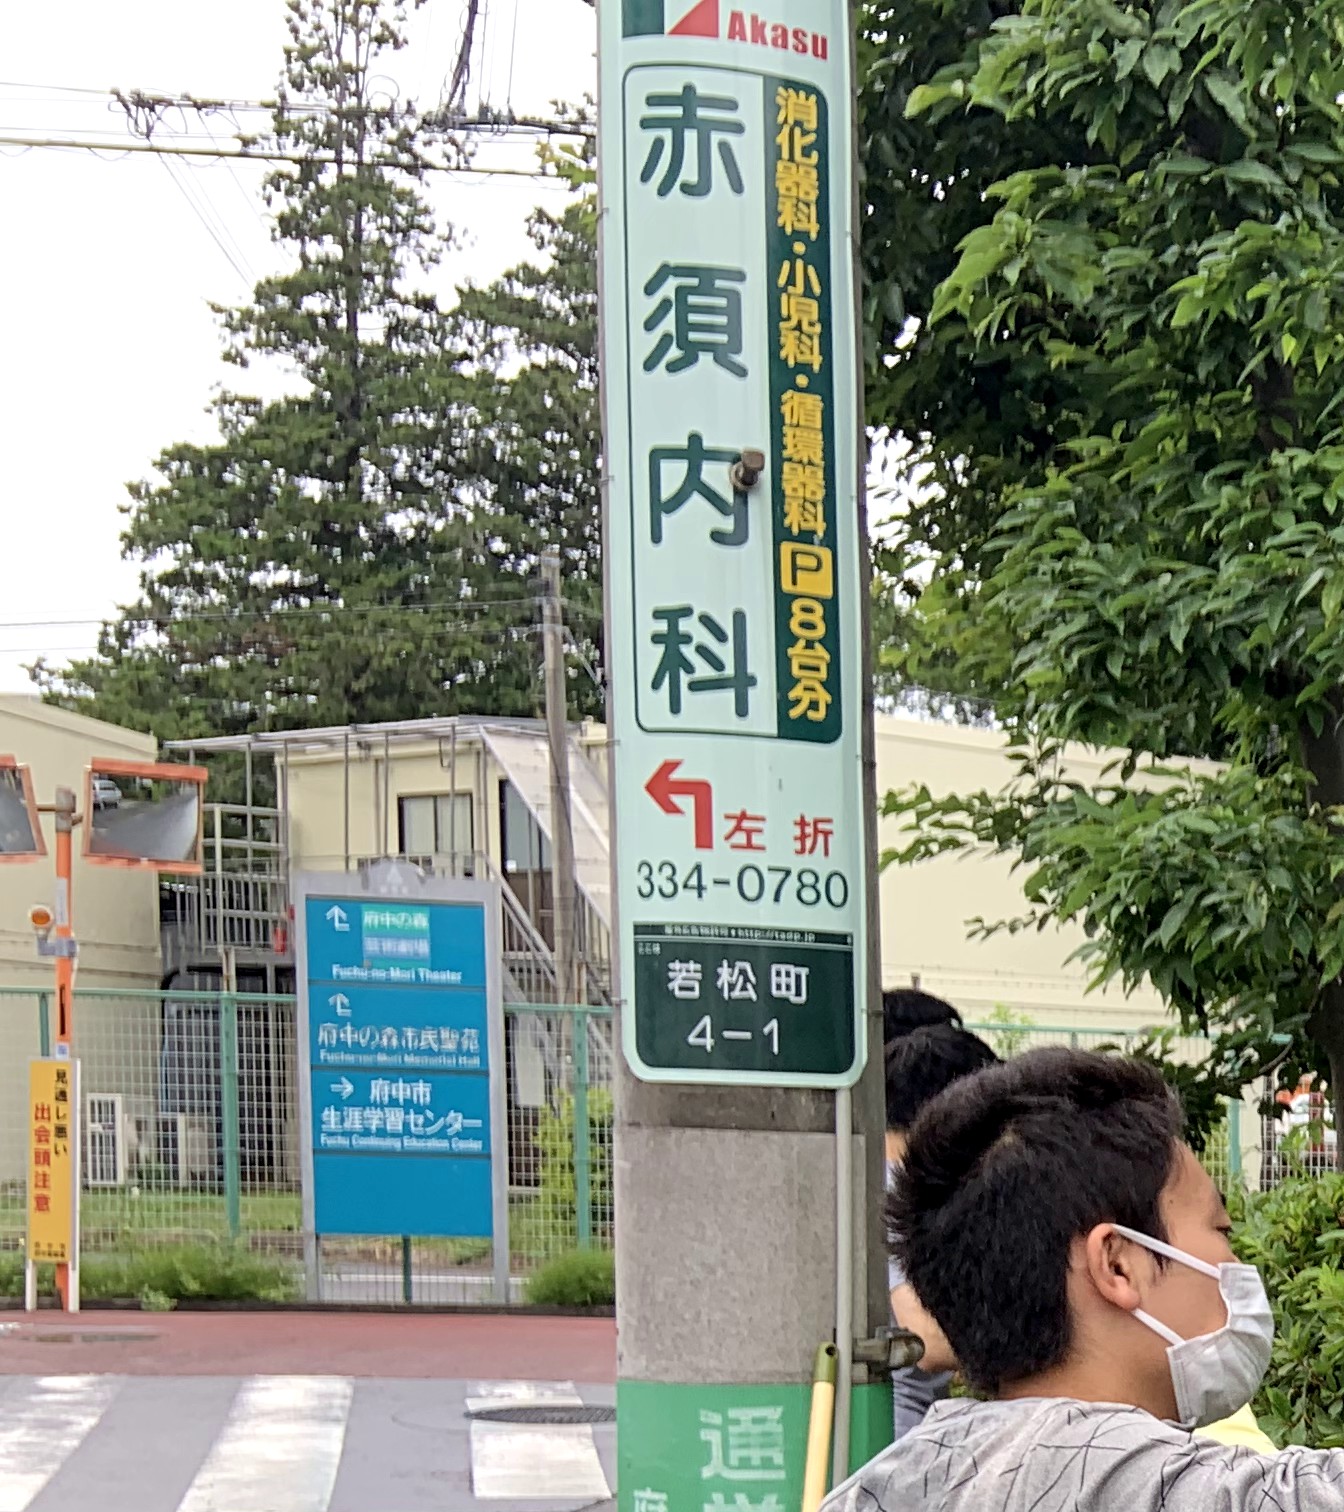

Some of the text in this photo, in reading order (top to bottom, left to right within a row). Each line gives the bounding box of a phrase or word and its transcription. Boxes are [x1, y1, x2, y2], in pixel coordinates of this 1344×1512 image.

[727, 10, 829, 60] Akasu
[639, 82, 758, 719] 赤須内科
[636, 860, 850, 909] 334-0780
[667, 958, 810, 1005] 若松町
[370, 1077, 432, 1106] 府中市
[321, 1105, 483, 1136] 生涯学習センター
